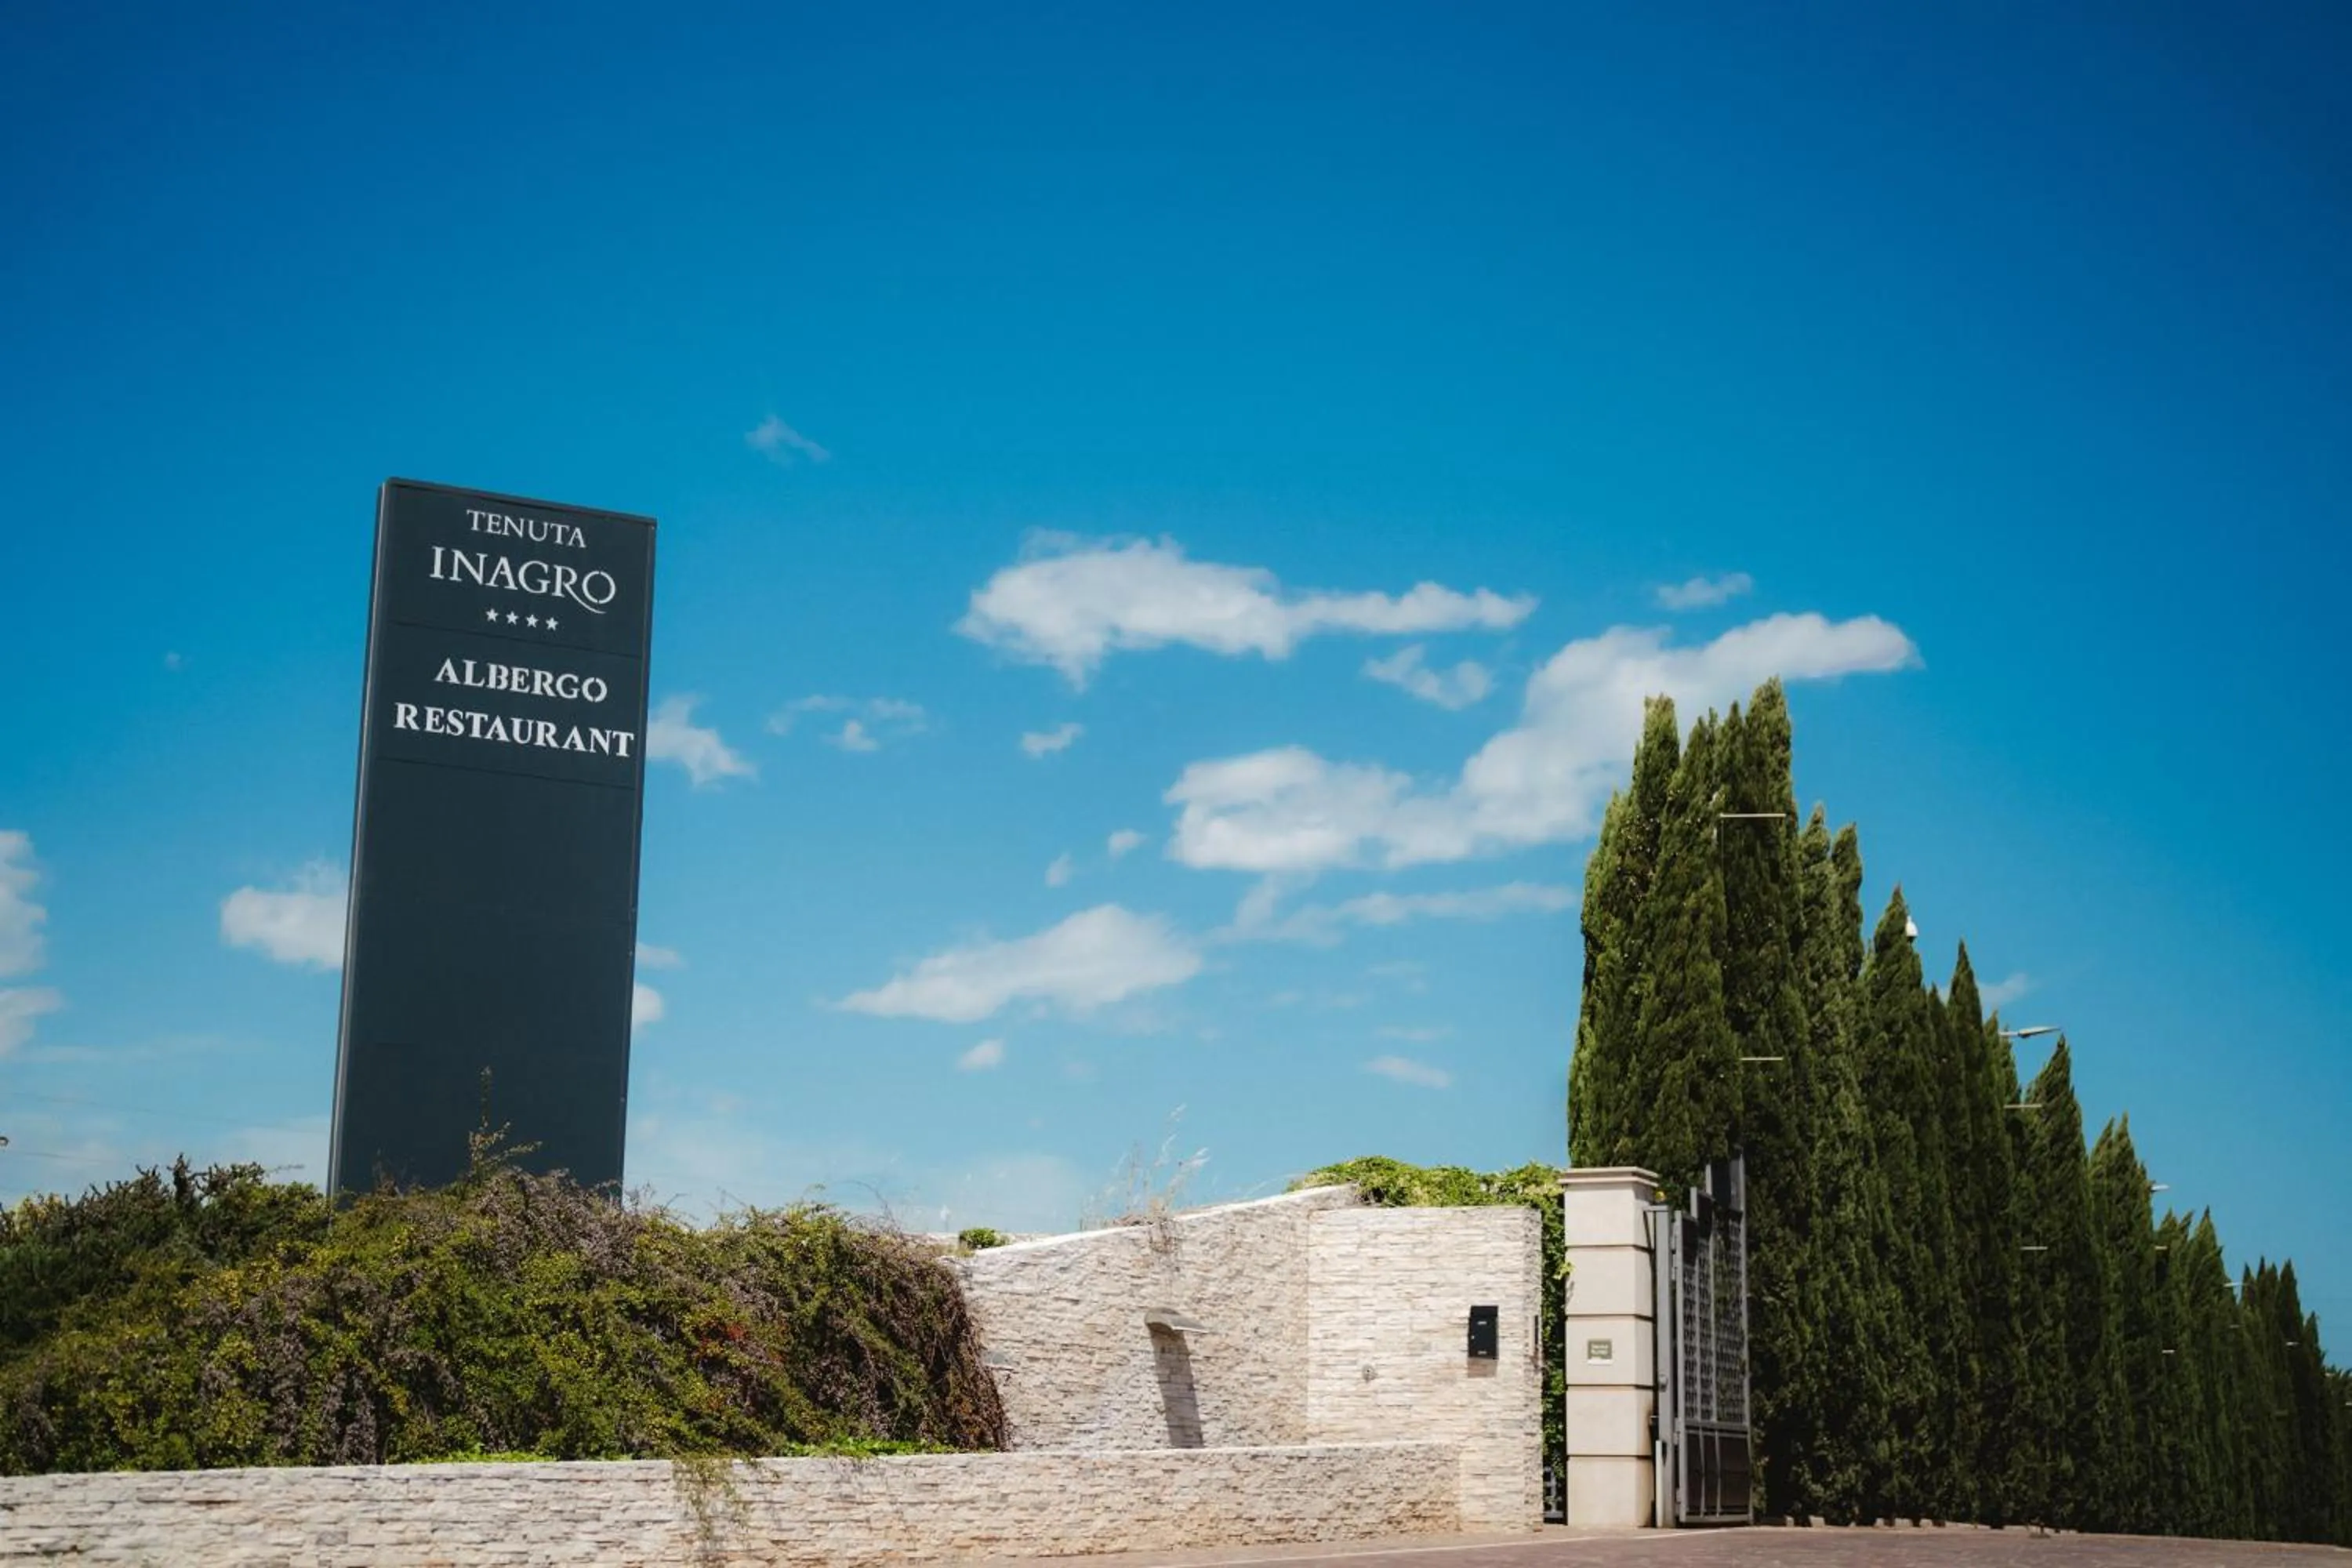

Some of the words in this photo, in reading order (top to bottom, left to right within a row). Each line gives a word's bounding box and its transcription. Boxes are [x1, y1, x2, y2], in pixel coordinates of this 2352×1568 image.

[466, 509, 586, 548] TENUTA
[430, 546, 616, 614] INAGRO
[435, 658, 608, 702] ALBERGO
[394, 702, 635, 757] RESTAURANT
